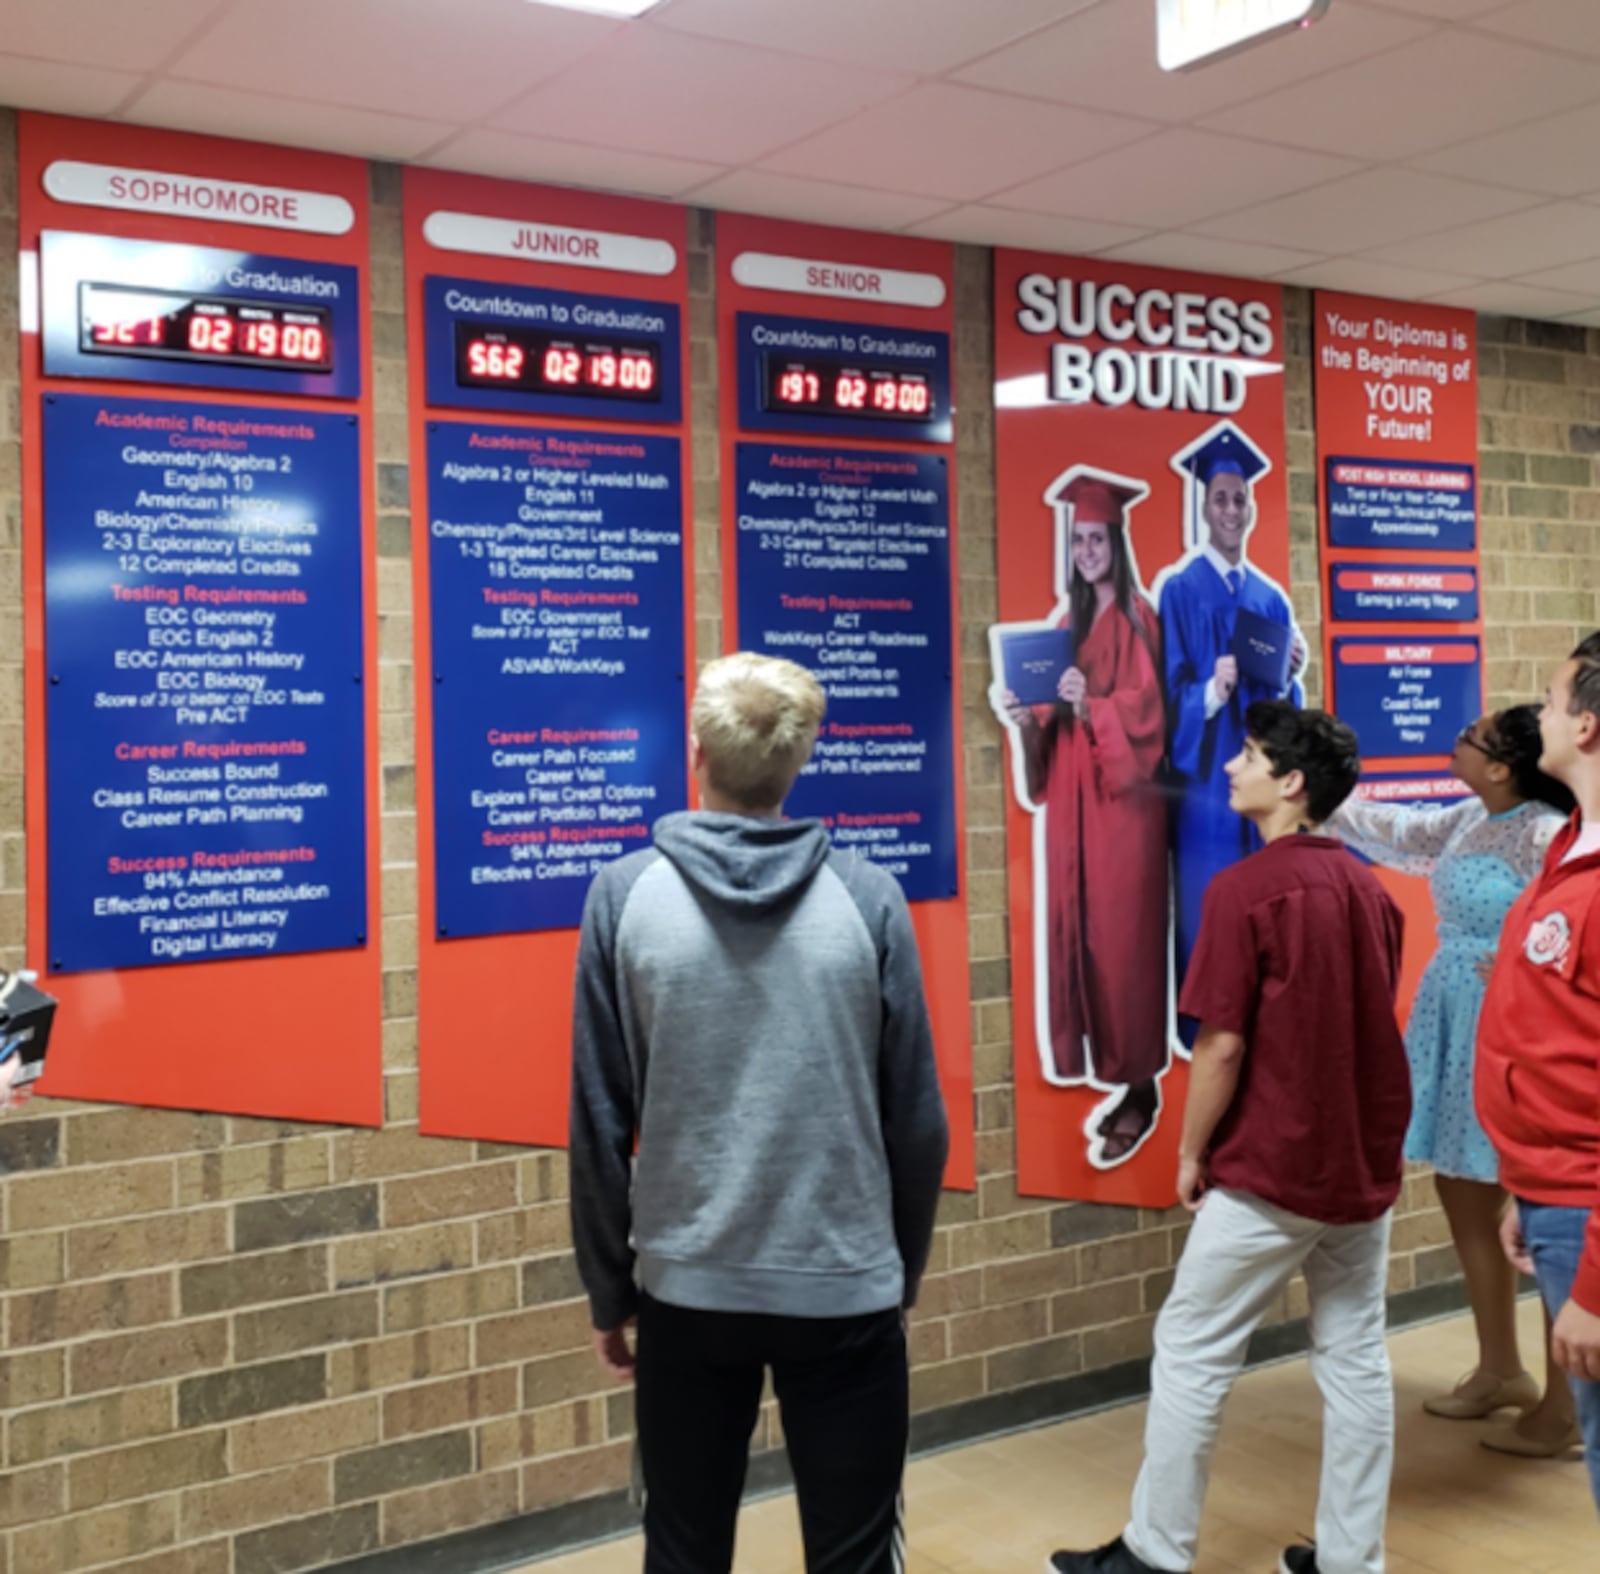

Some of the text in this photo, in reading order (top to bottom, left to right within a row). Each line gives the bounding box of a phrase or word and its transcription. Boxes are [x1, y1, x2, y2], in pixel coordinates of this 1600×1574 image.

[109, 176, 298, 220] SOPHOMORE
[512, 229, 599, 257] JUNIOR
[226, 267, 339, 298] Graduation
[807, 267, 881, 293] SENIOR
[445, 290, 664, 332] Countdown to Graduation
[1017, 274, 1273, 356] SUCCESS
[189, 318, 232, 352] 02
[245, 320, 278, 355] 19
[281, 325, 322, 359] 00
[752, 325, 935, 357] Countdown to Graduation
[1326, 313, 1466, 350] Your Diploma is
[469, 342, 652, 390] 562 02 19 00
[1322, 346, 1470, 384] the Beginning of
[1052, 343, 1246, 413] BOUND
[780, 374, 927, 412] 197 02 19 00
[1364, 382, 1432, 414] YOUR
[96, 410, 315, 440] Academic Requirements
[1367, 415, 1431, 441] Future!
[169, 434, 247, 450] Completion
[469, 433, 645, 457] Academic Requirements
[122, 446, 291, 473] Geometry/Algebra 2
[770, 453, 917, 474] Academic Requirements
[164, 470, 253, 491] English 10
[443, 462, 668, 489] Algebra 2 or Higher Leveled Math
[136, 491, 217, 510] American
[525, 486, 594, 504] English 11
[518, 505, 602, 523] Government
[815, 501, 859, 518] English
[102, 532, 312, 556] 2-3 Exploratory Electives
[591, 528, 625, 543] Level
[630, 528, 680, 545] Science
[460, 542, 658, 562] 1-3 Targeted Career Electives
[119, 555, 300, 576] 12 Completed Credits
[510, 561, 584, 580] Completed
[587, 564, 633, 580] Credits
[112, 584, 306, 605] Testing Requirements
[483, 588, 638, 606] Testing Requirements
[780, 594, 912, 612] Testing Requirements
[145, 608, 275, 628] EOC Geometry
[502, 609, 622, 625] EOC Government
[834, 614, 860, 628] ACT
[148, 629, 273, 649] EOC English 2
[549, 639, 579, 655] ACT
[115, 651, 304, 670] EOC American History
[157, 672, 266, 693] EOC Biology
[176, 707, 249, 724] Pre ACT
[488, 728, 639, 744] Career Requirements
[829, 723, 912, 737] Requirements
[116, 740, 306, 759] Career Requirements
[492, 747, 636, 766] Career Path Focused
[148, 762, 278, 783] Success Bound
[526, 768, 605, 784] Career Visit
[94, 783, 327, 808] Class Resume Construction
[472, 785, 655, 808] Explore Flex Credit Options
[122, 805, 302, 828] Career Path Planning
[488, 804, 642, 825] Career Portfolio Begun
[837, 813, 920, 826] Requirements
[483, 825, 647, 846] Success Requirements
[108, 846, 315, 873] Success Requirements
[547, 840, 622, 858] Attendance
[144, 867, 283, 889] 94% Attendance
[472, 867, 532, 884] Effective
[536, 862, 586, 879] Conflict
[94, 884, 329, 915] Effective Conflict Resolution
[140, 910, 288, 933] Financial Literacy
[152, 932, 277, 957] Digital Literacy
